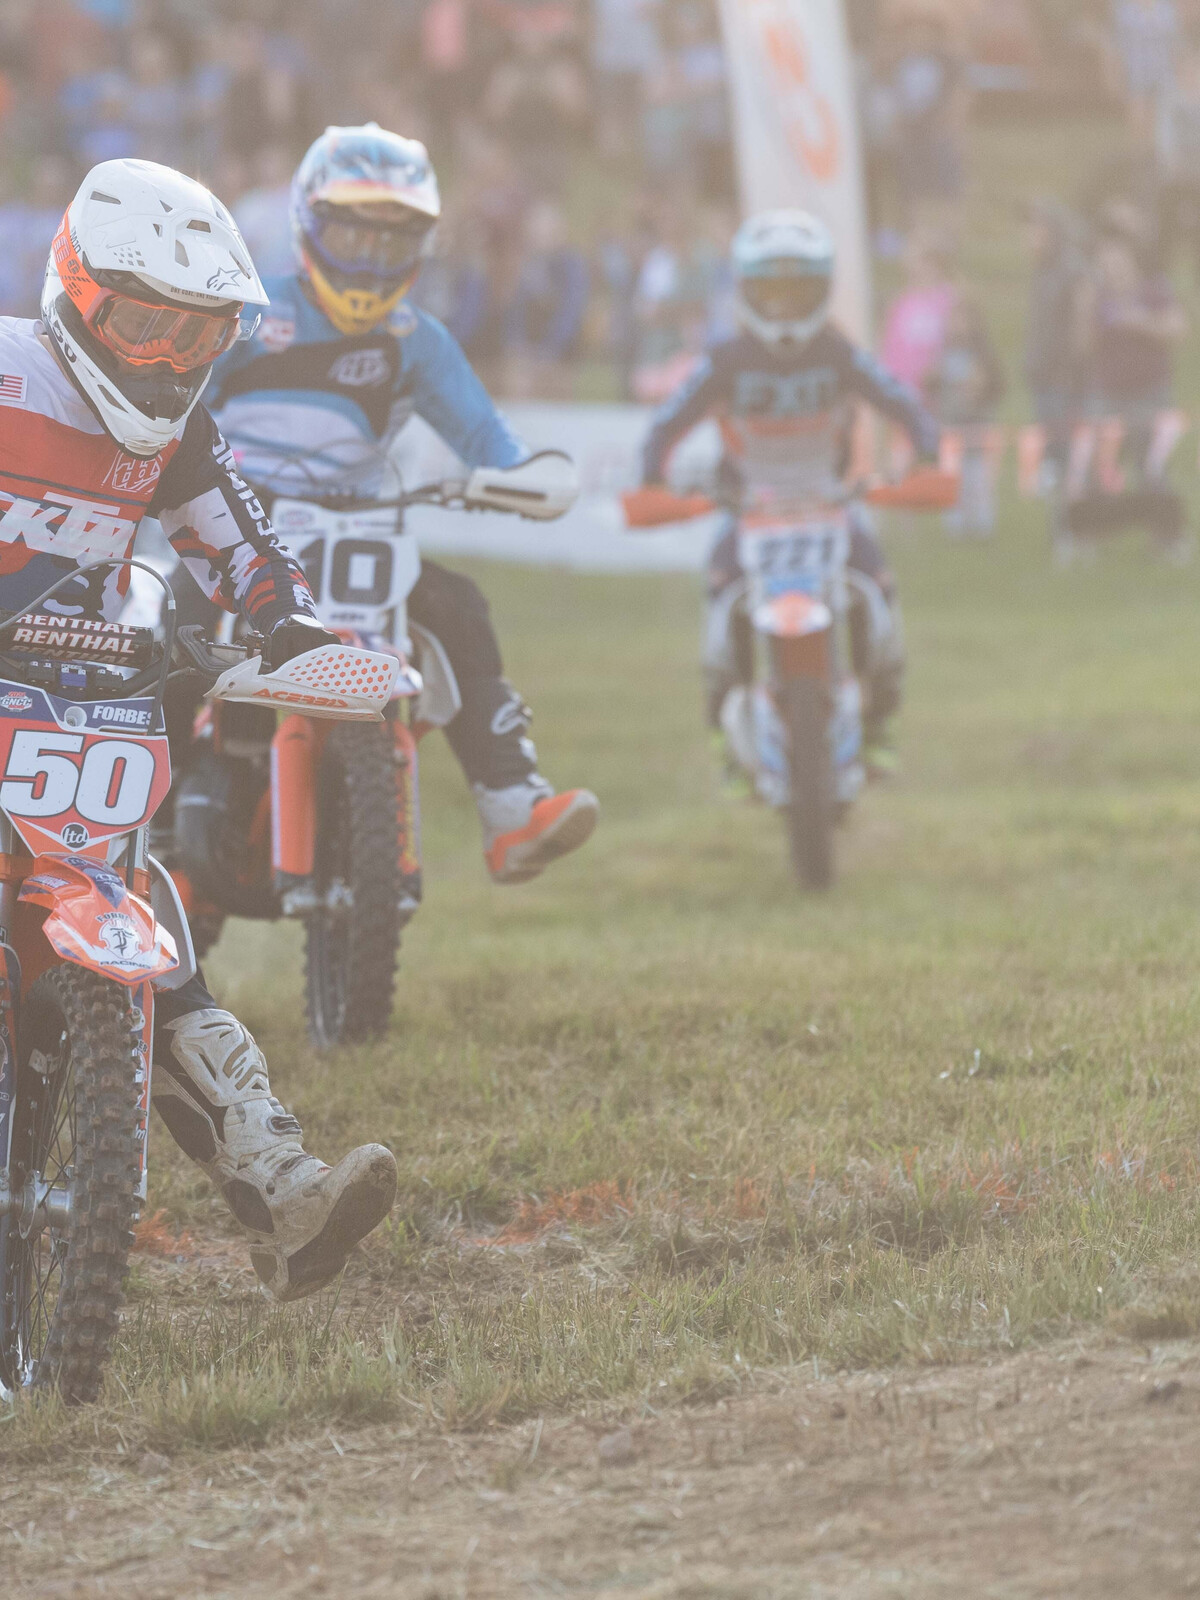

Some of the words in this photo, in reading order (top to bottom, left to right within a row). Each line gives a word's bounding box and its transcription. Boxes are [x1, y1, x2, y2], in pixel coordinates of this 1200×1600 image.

[16, 613, 137, 635] RENTHAL
[13, 628, 135, 654] RENTHAL
[1, 697, 32, 707] GNCC
[252, 687, 349, 709] ACERBIS
[0, 728, 157, 827] 50
[64, 826, 88, 844] ltd
